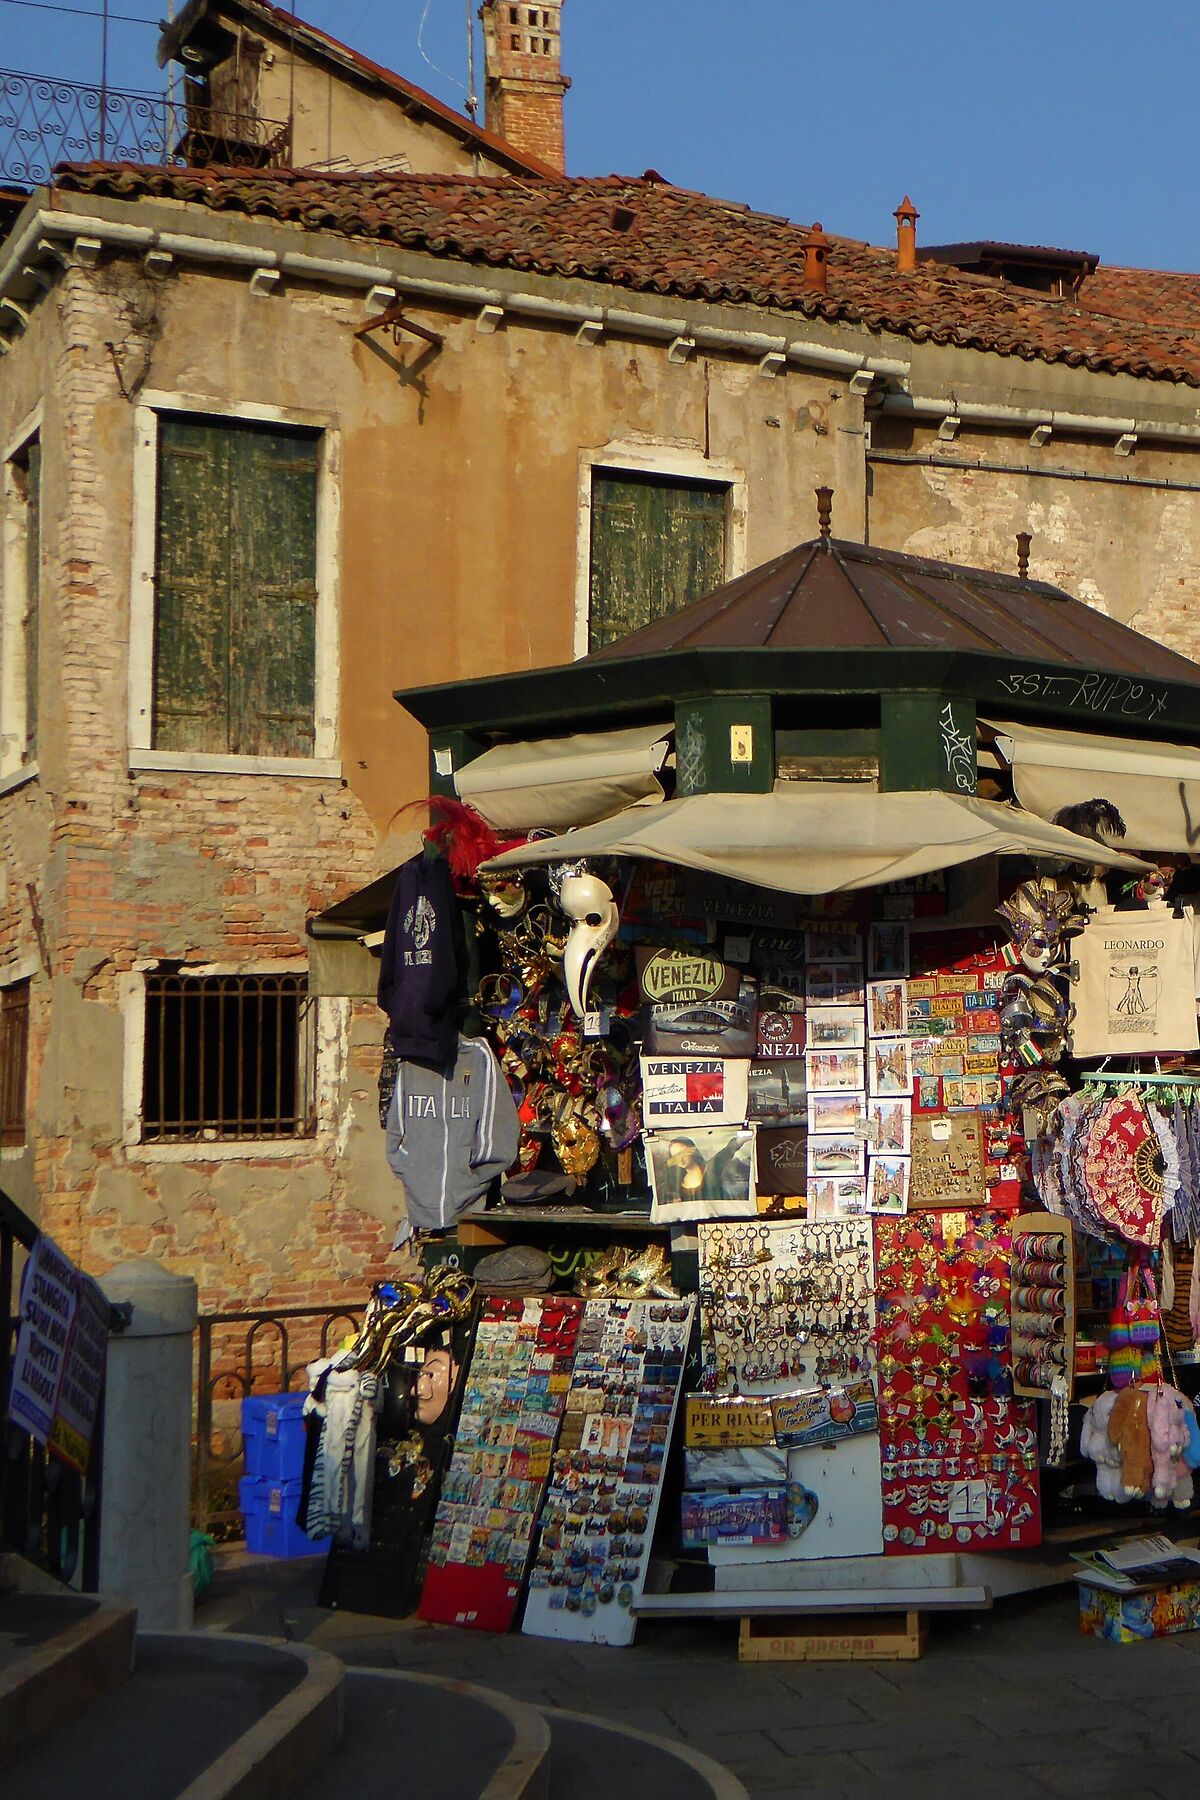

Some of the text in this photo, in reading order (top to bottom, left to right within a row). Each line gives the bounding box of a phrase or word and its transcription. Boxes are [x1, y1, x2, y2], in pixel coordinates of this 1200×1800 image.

[1104, 940, 1165, 950] LEONARDO
[650, 961, 718, 991] VENEZIA
[672, 988, 698, 1002] ITALIA
[933, 1003, 961, 1011] RIALTO
[650, 1062, 724, 1074] VENEZIA
[659, 1102, 715, 1113] ITALIA
[692, 1414, 719, 1427] PER
